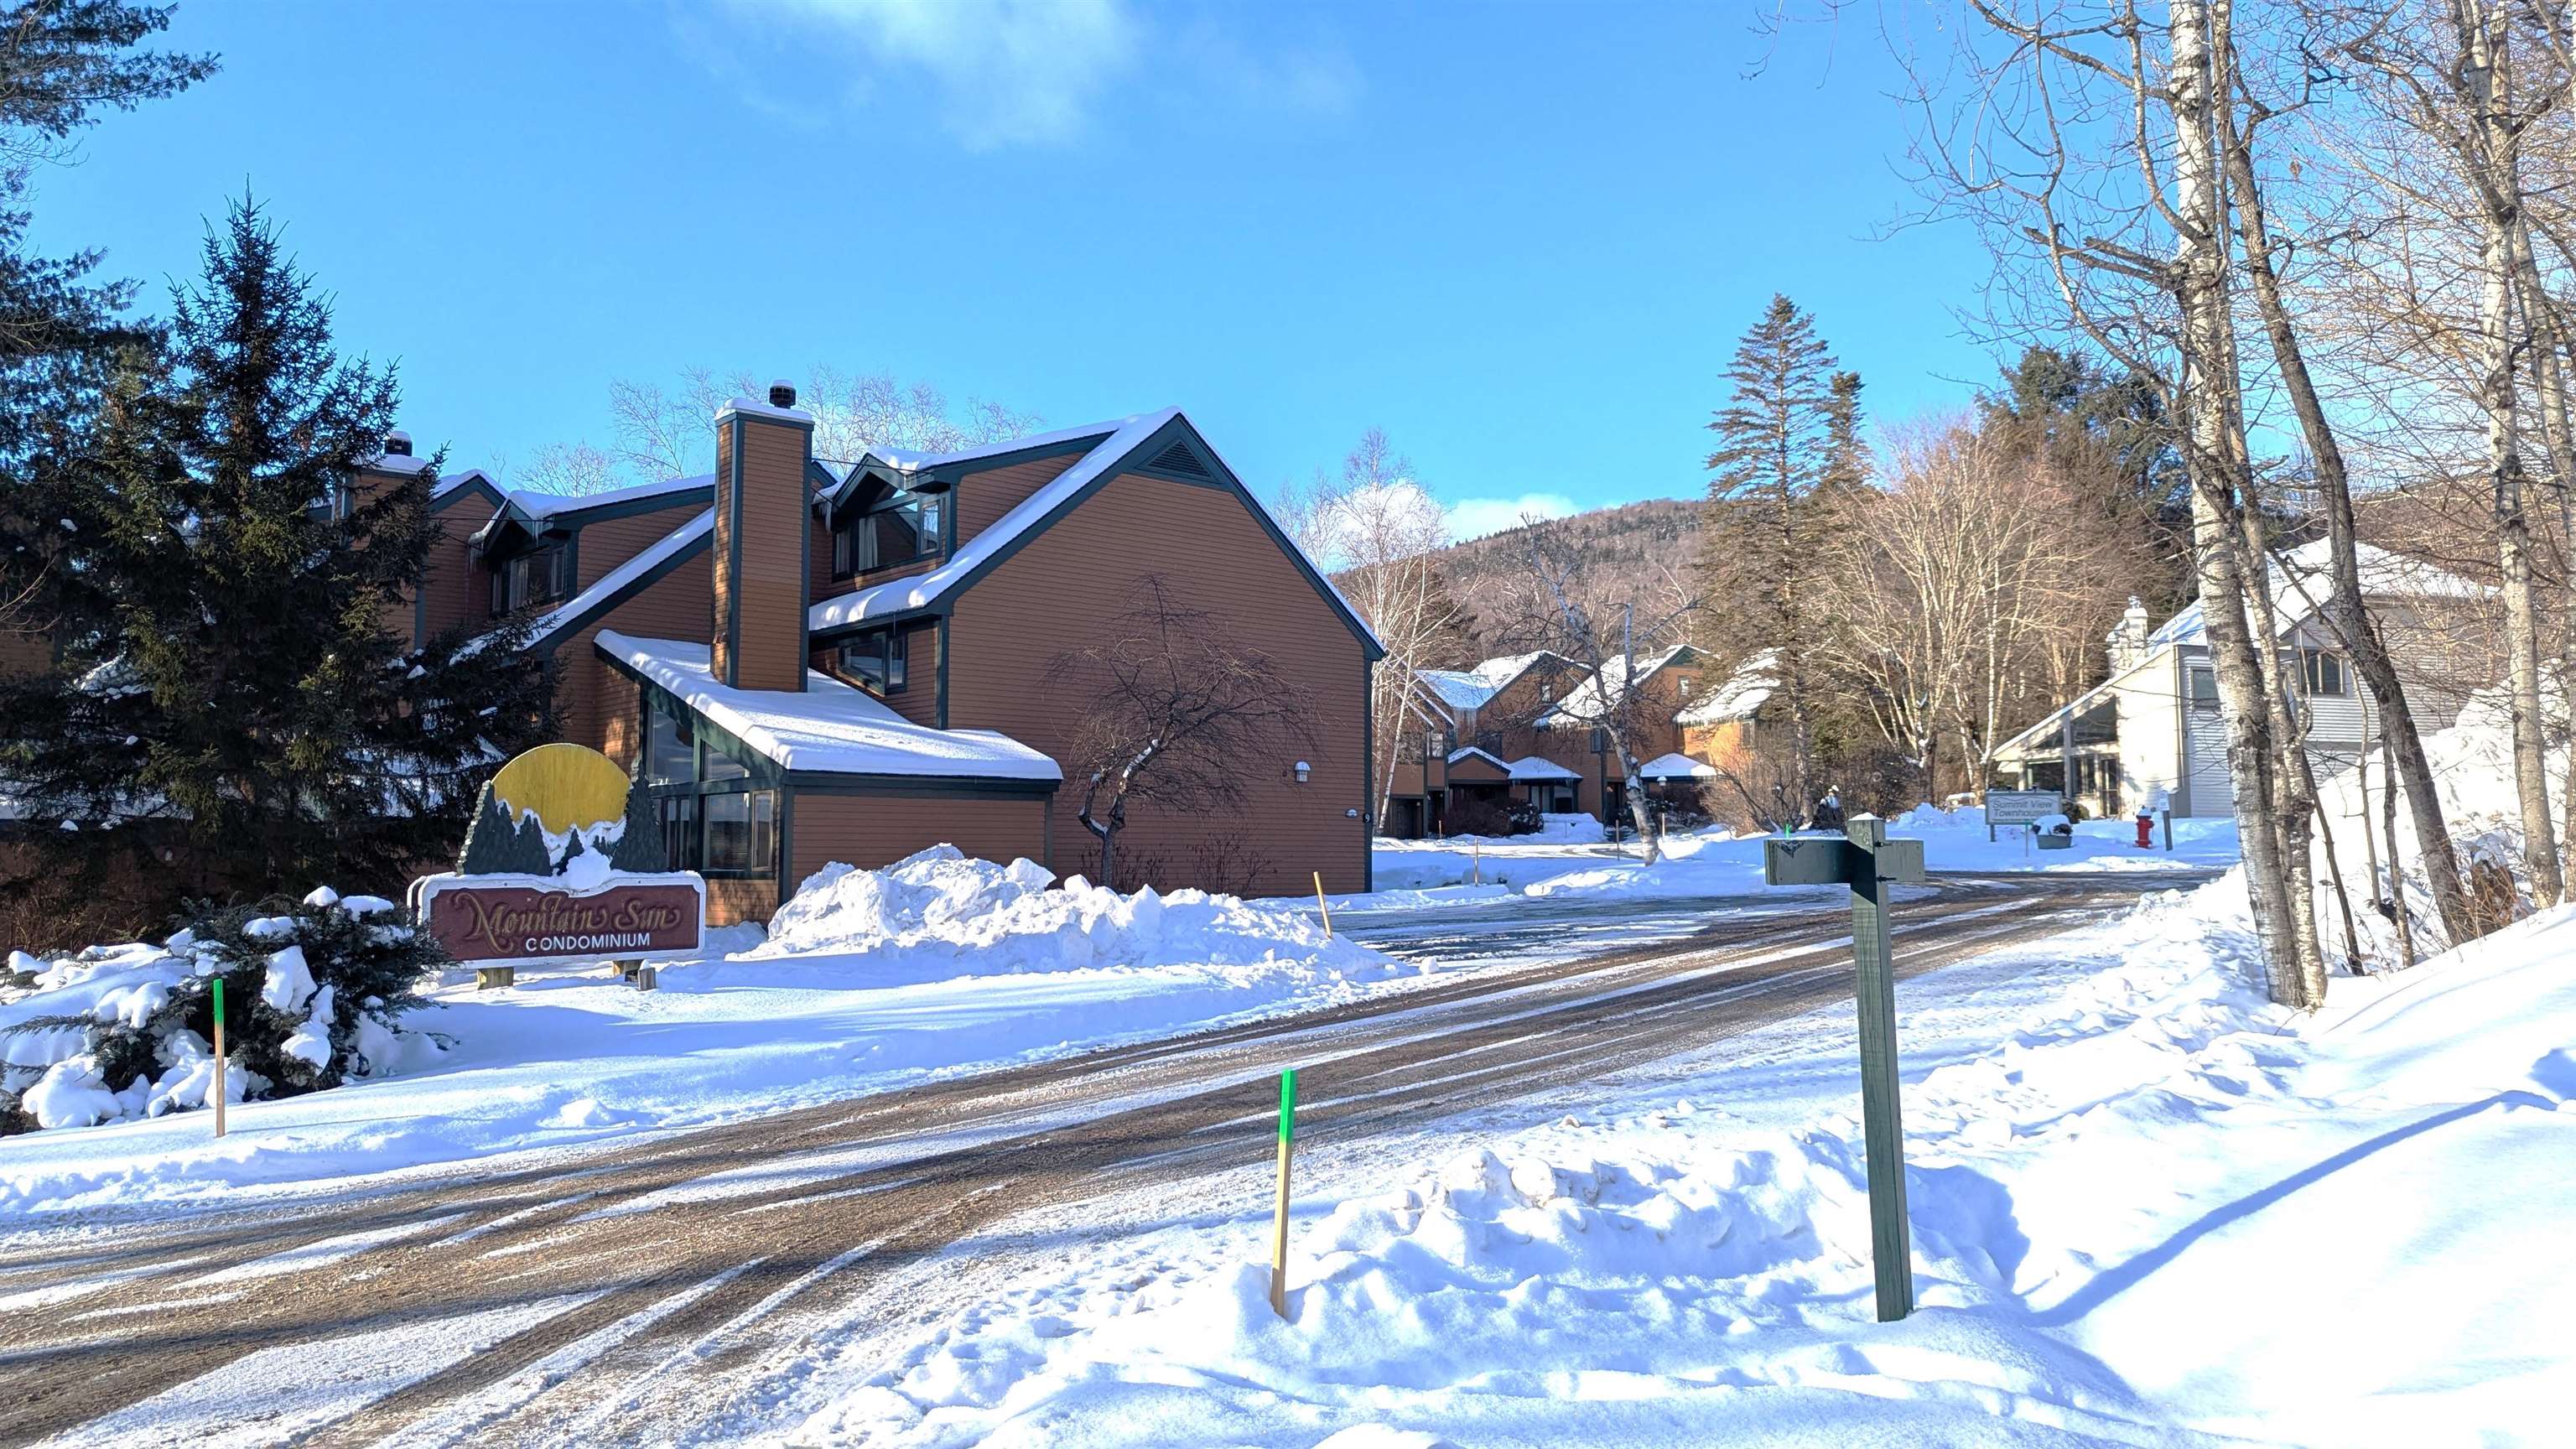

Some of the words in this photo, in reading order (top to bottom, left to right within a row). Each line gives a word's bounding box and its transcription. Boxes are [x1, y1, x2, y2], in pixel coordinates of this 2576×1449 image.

[2030, 800, 2053, 808] View
[1365, 813, 1370, 823] 9
[452, 891, 607, 953] Mountain
[615, 899, 681, 931] Sun
[526, 932, 651, 953] CONDOMINIUM
